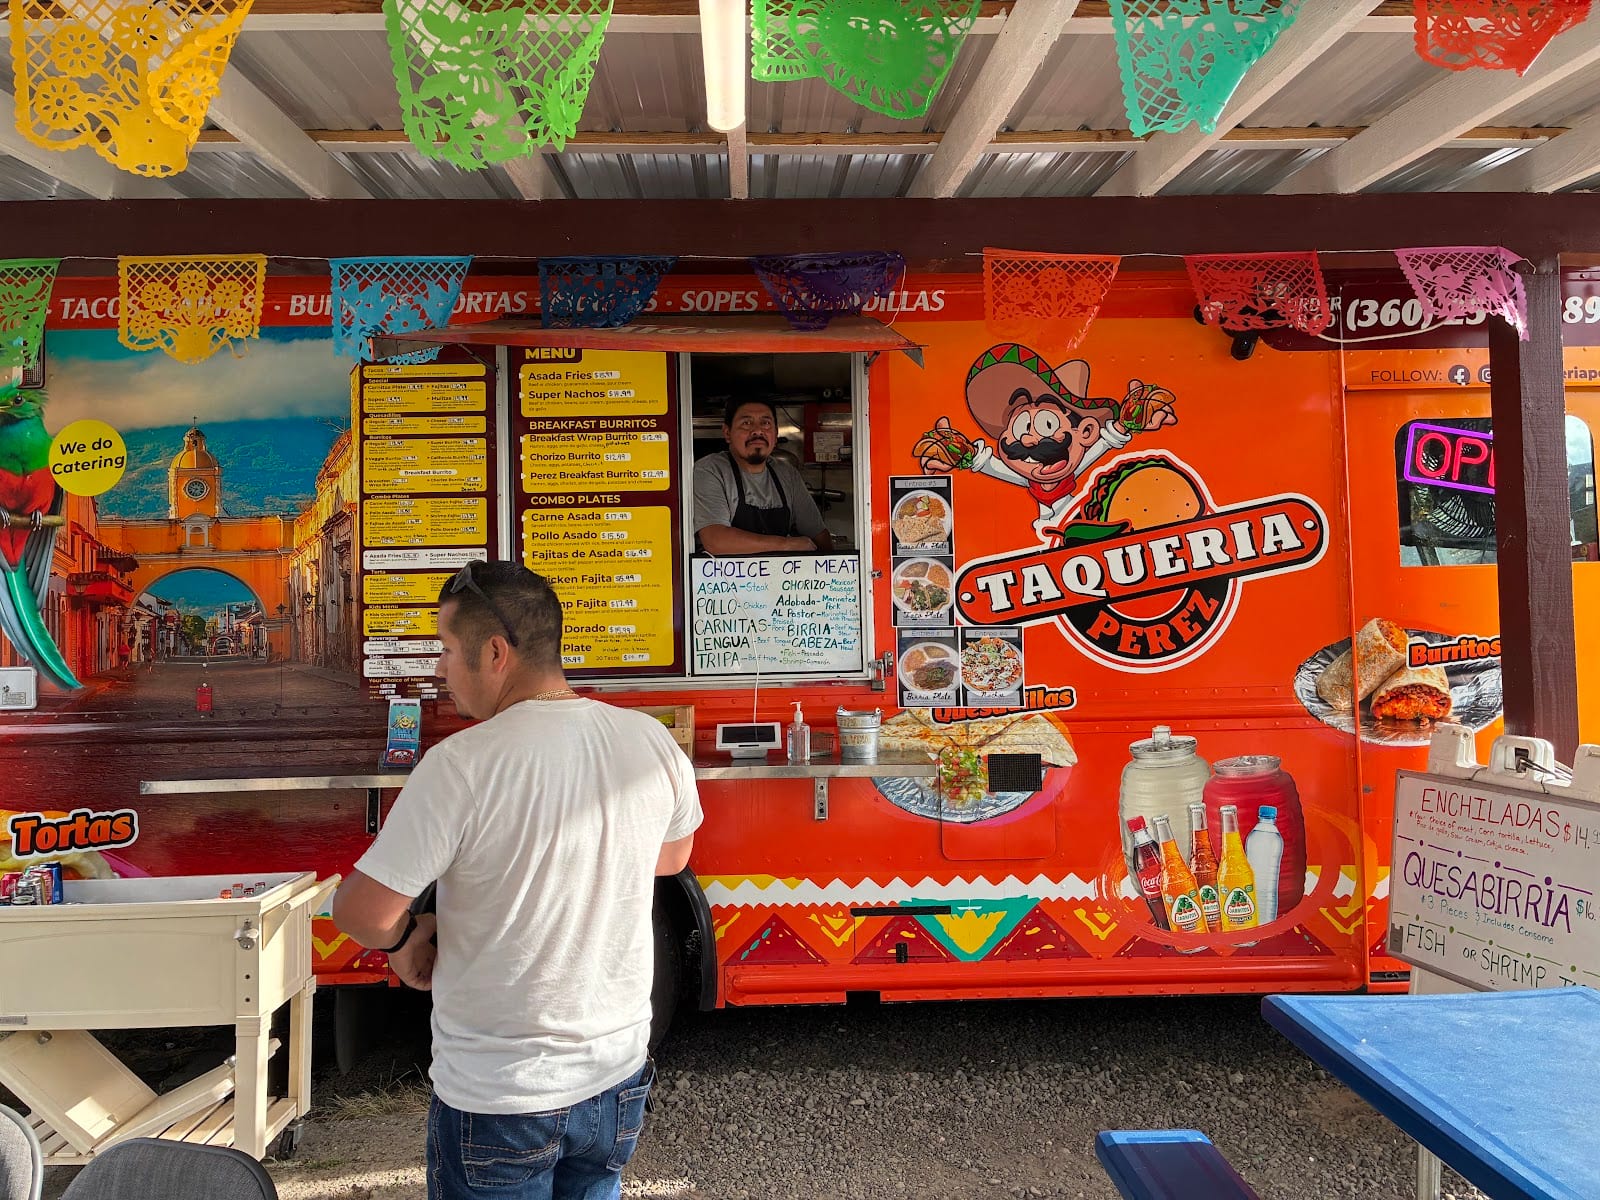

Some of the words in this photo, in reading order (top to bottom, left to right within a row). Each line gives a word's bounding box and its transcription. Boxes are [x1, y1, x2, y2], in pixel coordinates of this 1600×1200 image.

[451, 291, 528, 314] ORTAS
[680, 290, 760, 312] SOPES
[525, 347, 576, 360] MENU
[528, 372, 562, 381] Asada
[565, 371, 592, 380] Fries
[1371, 369, 1443, 382] FOLLOW:
[528, 390, 561, 400] Super
[564, 389, 606, 399] Nachos
[529, 419, 597, 430] BREAKFAST
[599, 418, 658, 429] BURRITOS
[529, 433, 575, 442] Breakfast
[577, 434, 603, 443] Wrap
[605, 432, 638, 441] Burrito
[60, 441, 87, 456] We
[91, 437, 113, 451] do
[529, 452, 566, 462] Chorizo
[568, 452, 601, 461] Burrito
[1415, 432, 1496, 488] OP
[52, 455, 125, 475] Catering
[530, 472, 557, 480] Perez
[559, 471, 605, 480] Breakfast
[606, 470, 639, 479] Burrito
[530, 495, 575, 505] COMBO
[578, 494, 621, 505] PLATES
[531, 513, 564, 522] Carne
[567, 512, 601, 521] Asada
[531, 531, 560, 541] Pollo
[563, 530, 598, 540] Asado
[531, 549, 569, 561] Fajitas
[572, 549, 585, 559] de
[588, 548, 623, 558] Asada
[702, 560, 771, 578] CHOICE
[782, 560, 802, 575] OF
[814, 559, 858, 574] MEAT
[976, 512, 1303, 615] TAQUERIA
[547, 575, 577, 584] icken
[581, 574, 612, 585] Fajita
[781, 579, 826, 591] CHORIZO
[696, 581, 738, 595] ASADA
[576, 598, 607, 610] Fajita
[696, 597, 738, 617] POLLO
[775, 594, 816, 607] Adobada
[771, 608, 783, 617] AL
[787, 608, 817, 618] Pastor
[564, 624, 606, 634] Dorado
[694, 618, 768, 636] CARNITAS
[1085, 588, 1221, 657] PEREZ
[787, 622, 831, 637] BIRRIA
[563, 643, 592, 653] Plate
[695, 635, 751, 652] LENGUA
[791, 637, 838, 649] CABEZA
[1410, 637, 1500, 666] Burritos
[696, 651, 741, 669] TRIPA
[1420, 788, 1561, 839] ENCHILADAS
[13, 813, 133, 855] Tortas
[1402, 851, 1573, 935] QUESABIRRIA
[1440, 898, 1470, 921] Pieces
[1482, 911, 1516, 933] Includes
[1406, 922, 1447, 957] FISH
[1480, 948, 1548, 989] SHRIMP
